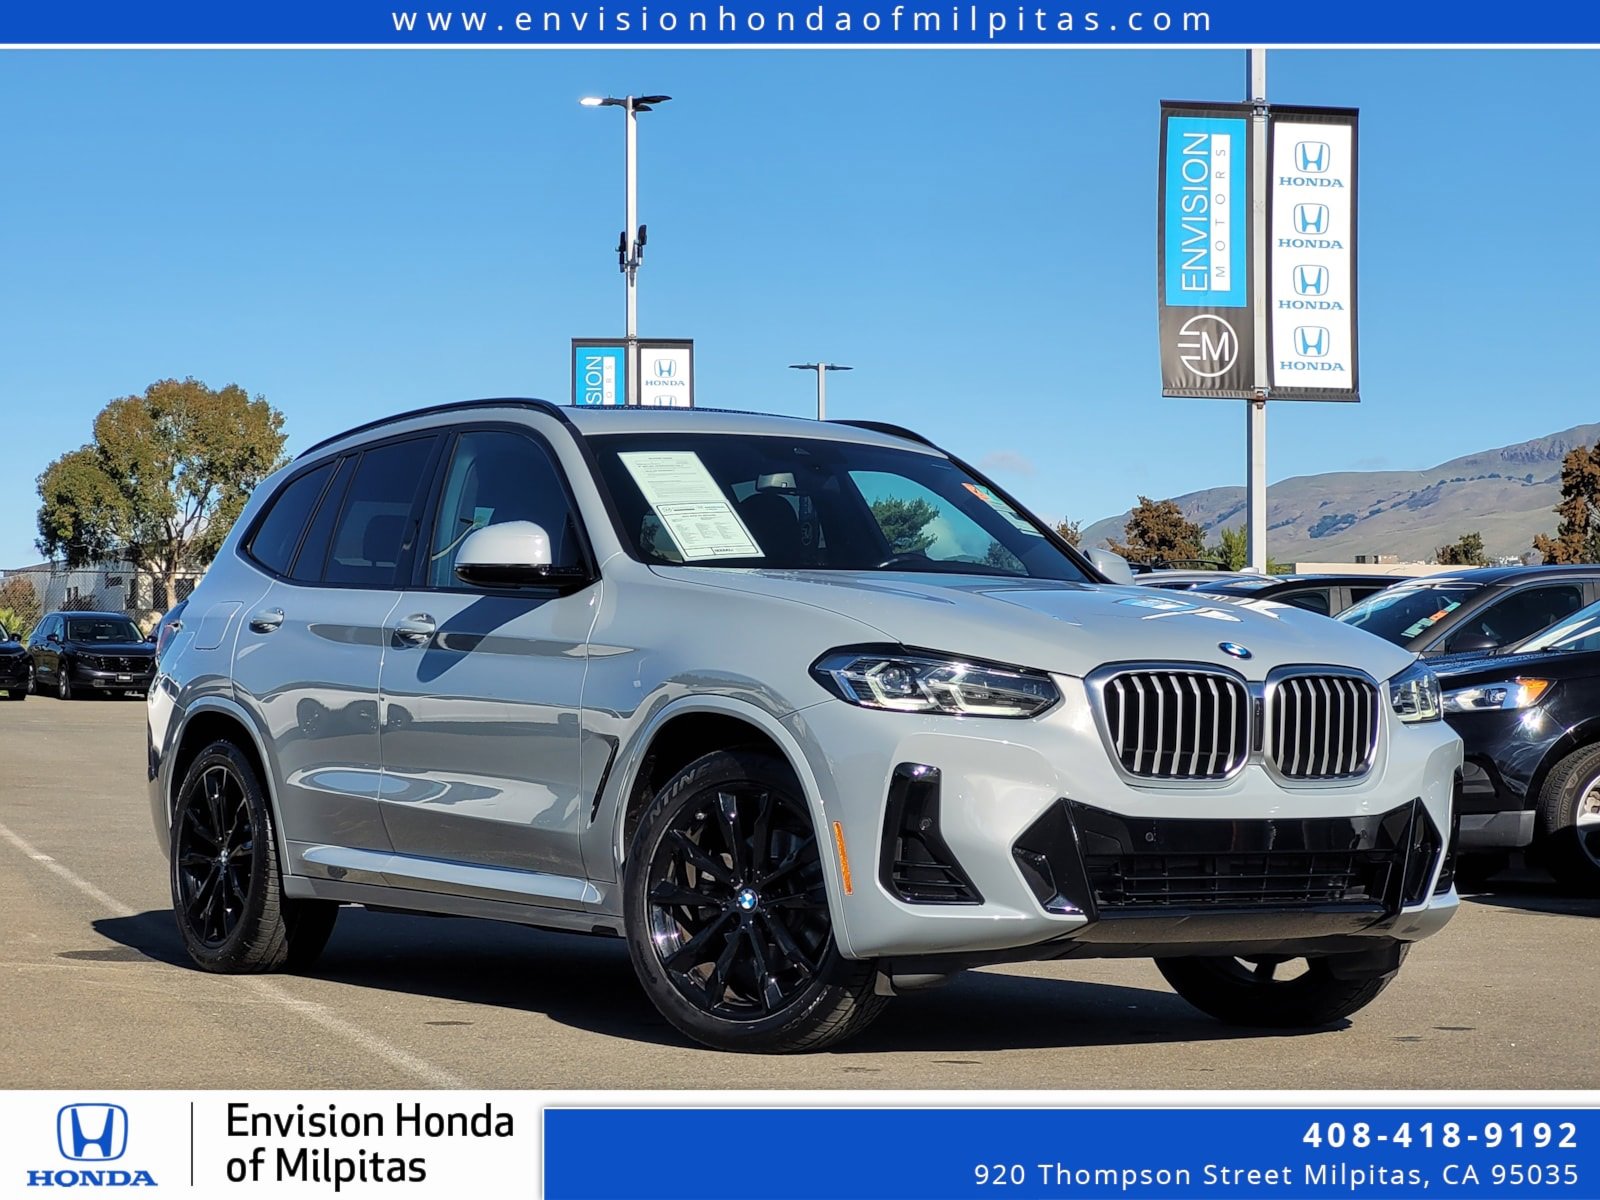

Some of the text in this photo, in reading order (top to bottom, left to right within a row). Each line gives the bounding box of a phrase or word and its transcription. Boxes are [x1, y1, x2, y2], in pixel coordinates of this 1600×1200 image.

[1279, 176, 1345, 188] HONDA
[1181, 132, 1209, 292] ENVISION
[1215, 148, 1226, 278] MOTORS
[1278, 238, 1344, 250] HONDA
[1279, 299, 1345, 311] HONDA
[1280, 361, 1345, 372] HONDA
